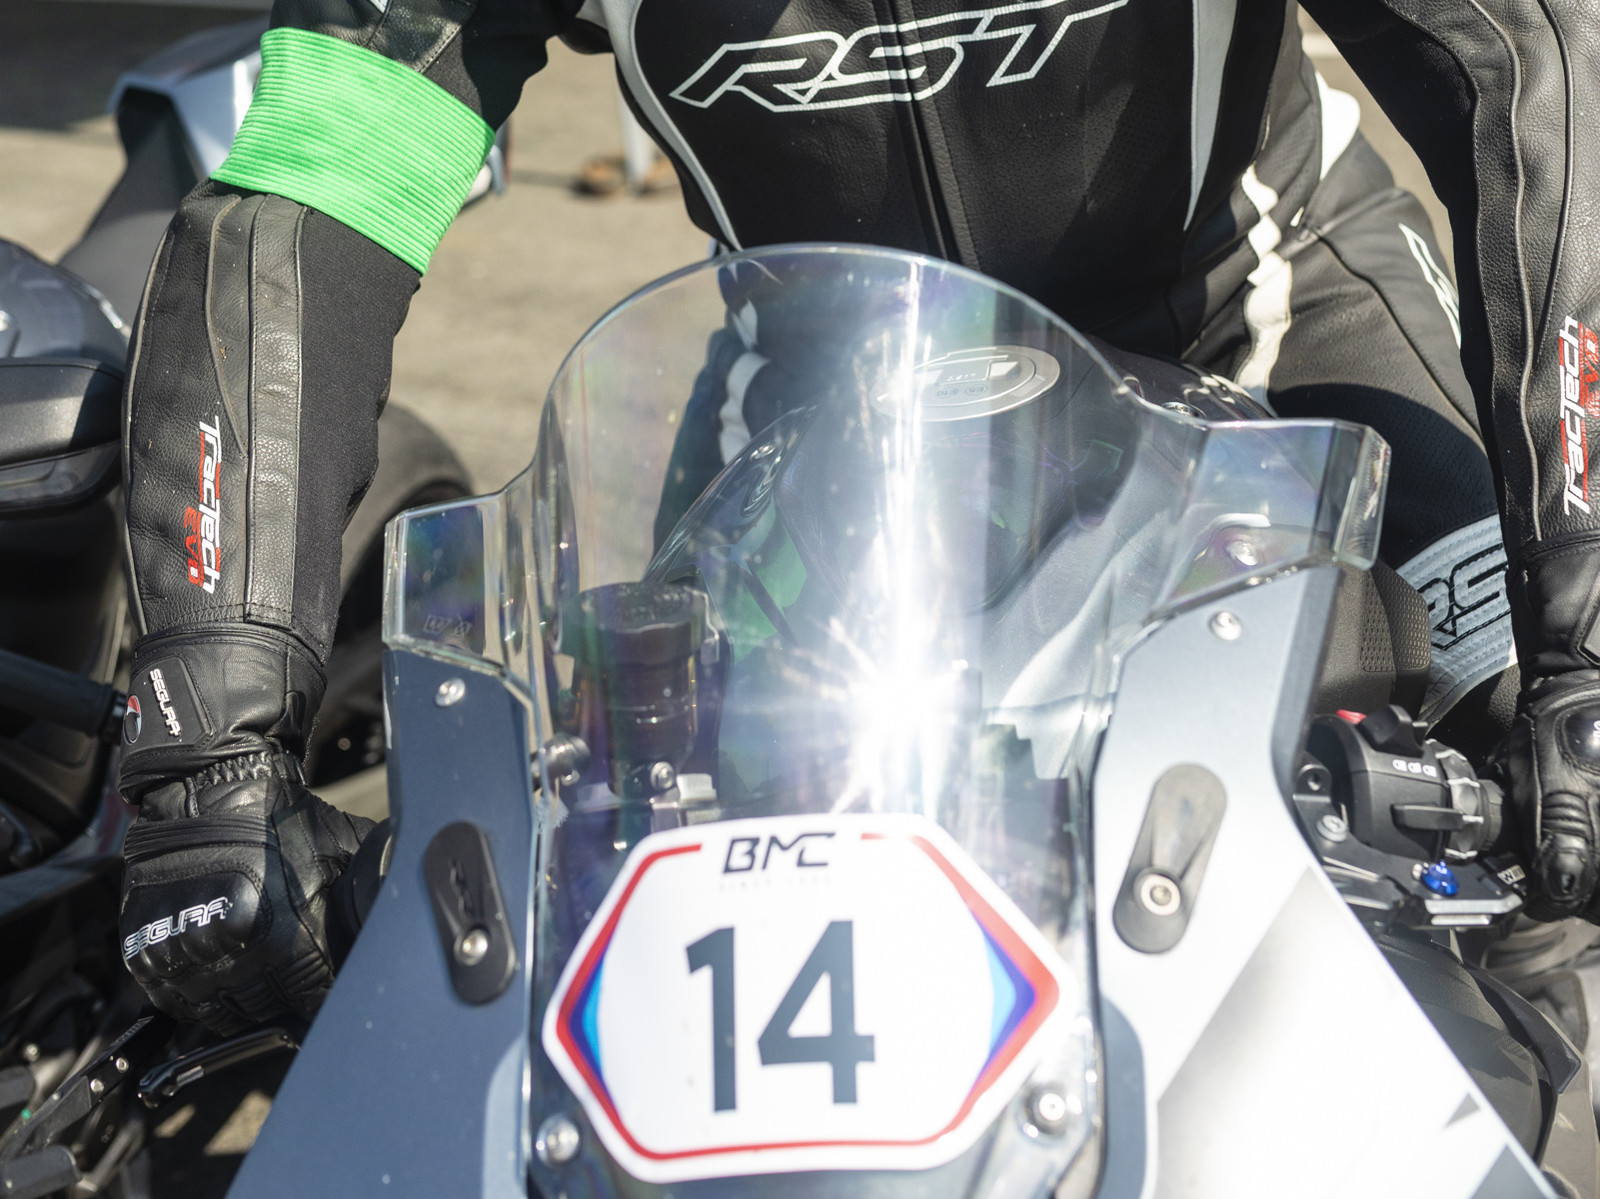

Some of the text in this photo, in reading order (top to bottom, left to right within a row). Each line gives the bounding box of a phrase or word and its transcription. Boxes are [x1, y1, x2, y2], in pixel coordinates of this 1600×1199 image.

[149, 667, 181, 737] SEGURA
[722, 832, 836, 874] BMC
[123, 896, 229, 960] SEGURA
[686, 919, 875, 1113] 14
